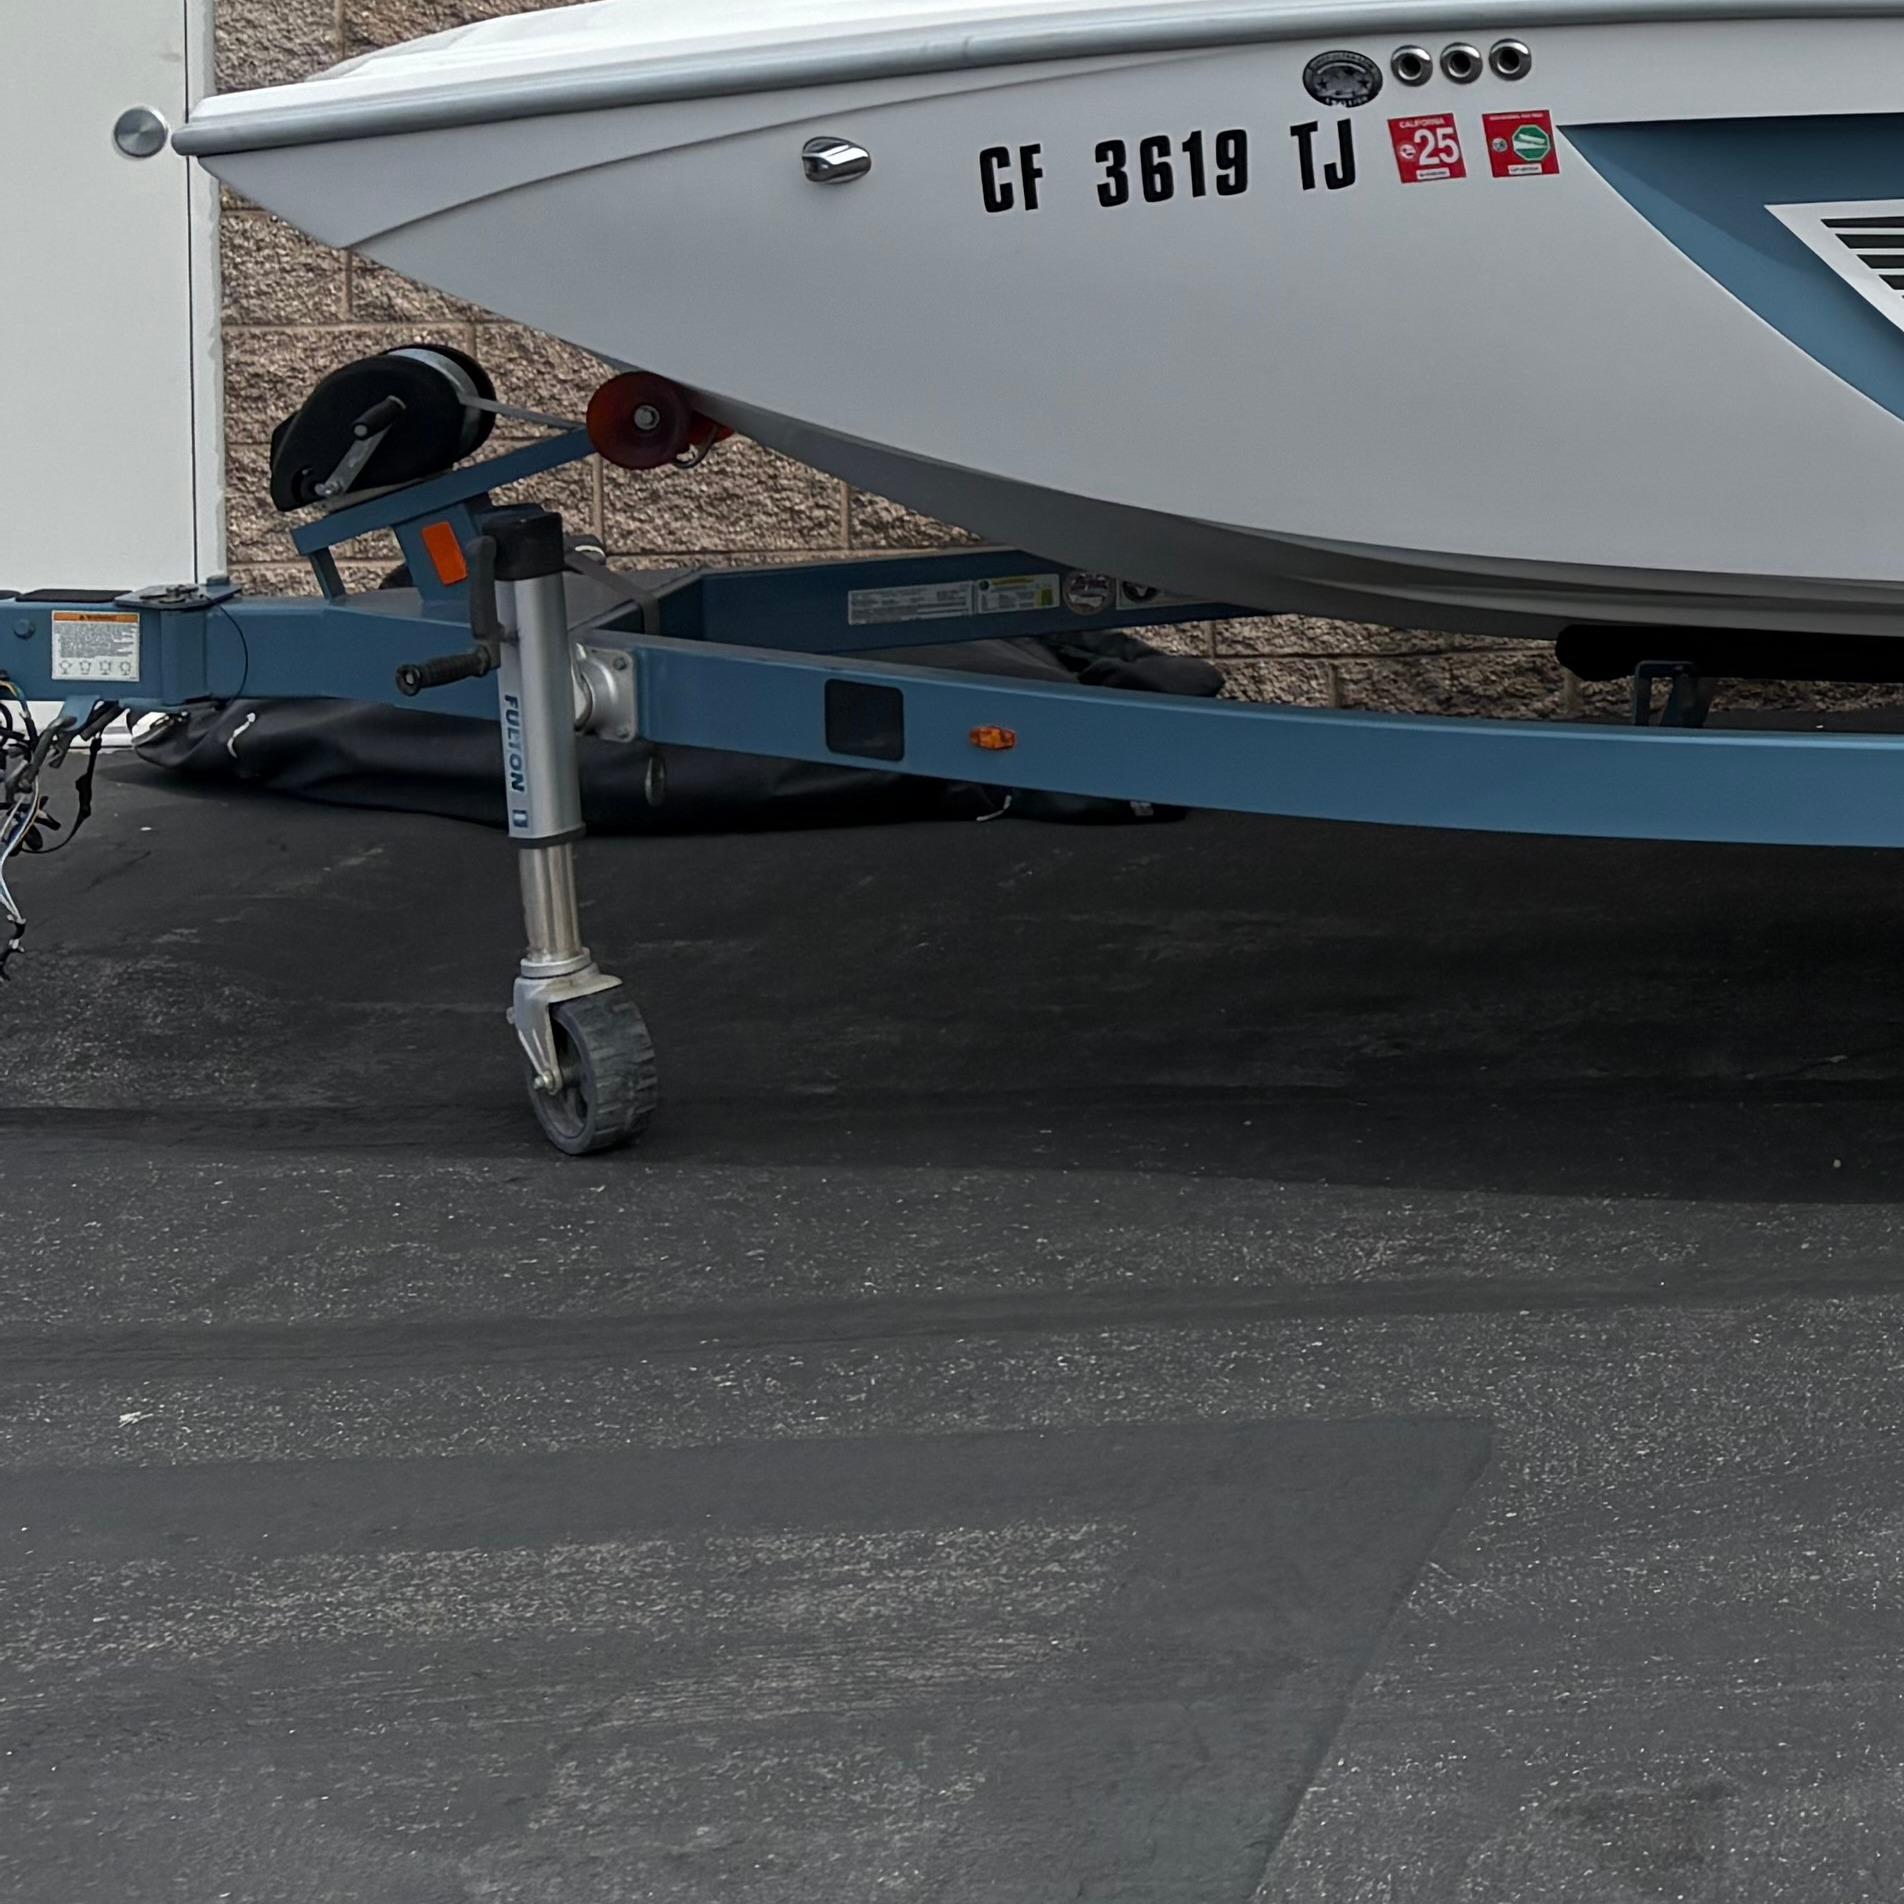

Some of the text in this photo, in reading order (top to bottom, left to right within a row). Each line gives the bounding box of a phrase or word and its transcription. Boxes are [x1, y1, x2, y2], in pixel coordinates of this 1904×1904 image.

[979, 118, 1356, 213] CF 3619 TJ
[1413, 127, 1461, 166] 25
[504, 694, 525, 793] FULTON
